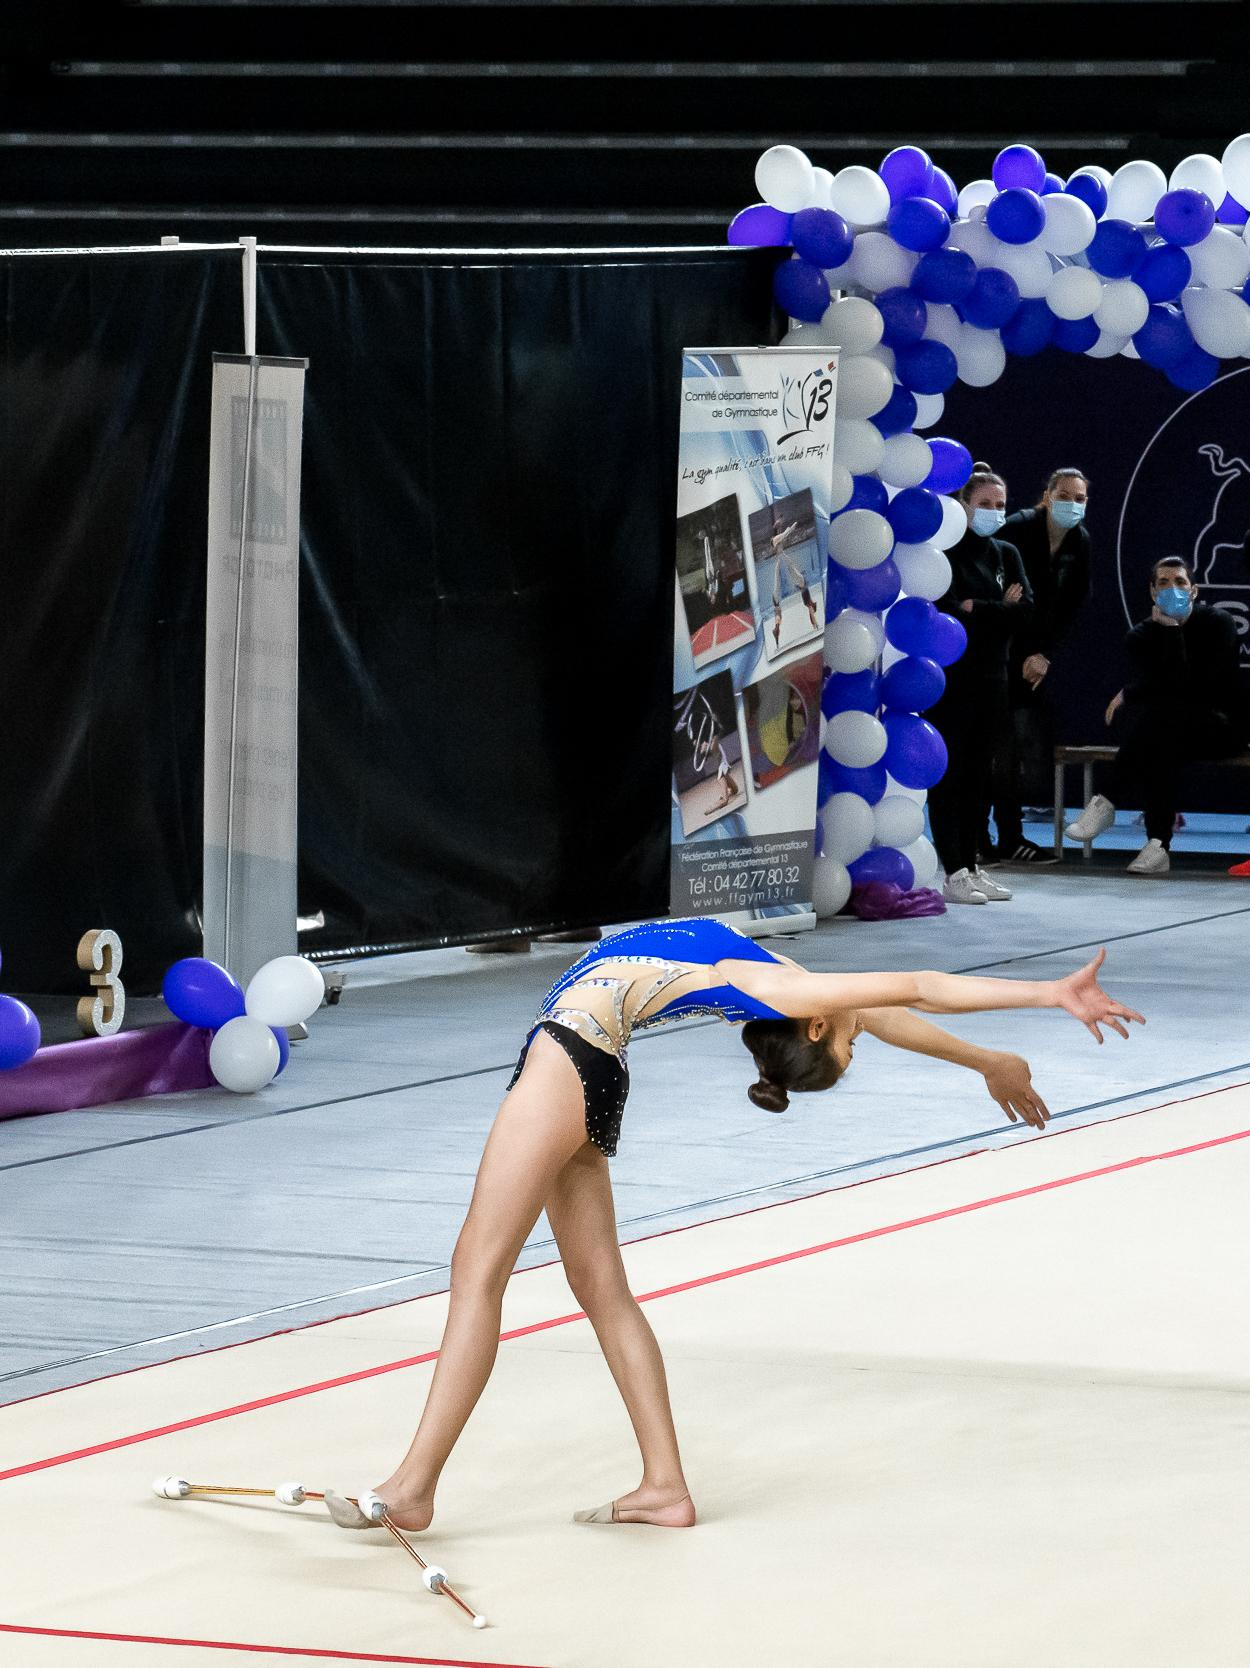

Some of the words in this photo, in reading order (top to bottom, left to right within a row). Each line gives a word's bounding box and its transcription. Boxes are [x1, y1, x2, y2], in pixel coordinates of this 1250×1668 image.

[685, 391, 717, 401] Comité
[718, 388, 779, 402] départemental
[712, 409, 722, 418] de
[725, 407, 778, 419] Gymnastique
[682, 467, 694, 479] La
[681, 850, 719, 862] Fédération
[753, 845, 763, 854] de
[764, 841, 808, 854] Gymnastique
[702, 861, 727, 872] Comité
[728, 855, 780, 869] départemental
[781, 854, 788, 863] 13
[714, 875, 730, 892] 04
[732, 872, 748, 889] 42
[751, 870, 765, 887] 77
[767, 868, 782, 885] 80
[785, 866, 799, 883] 32
[77, 929, 125, 1037] 3
